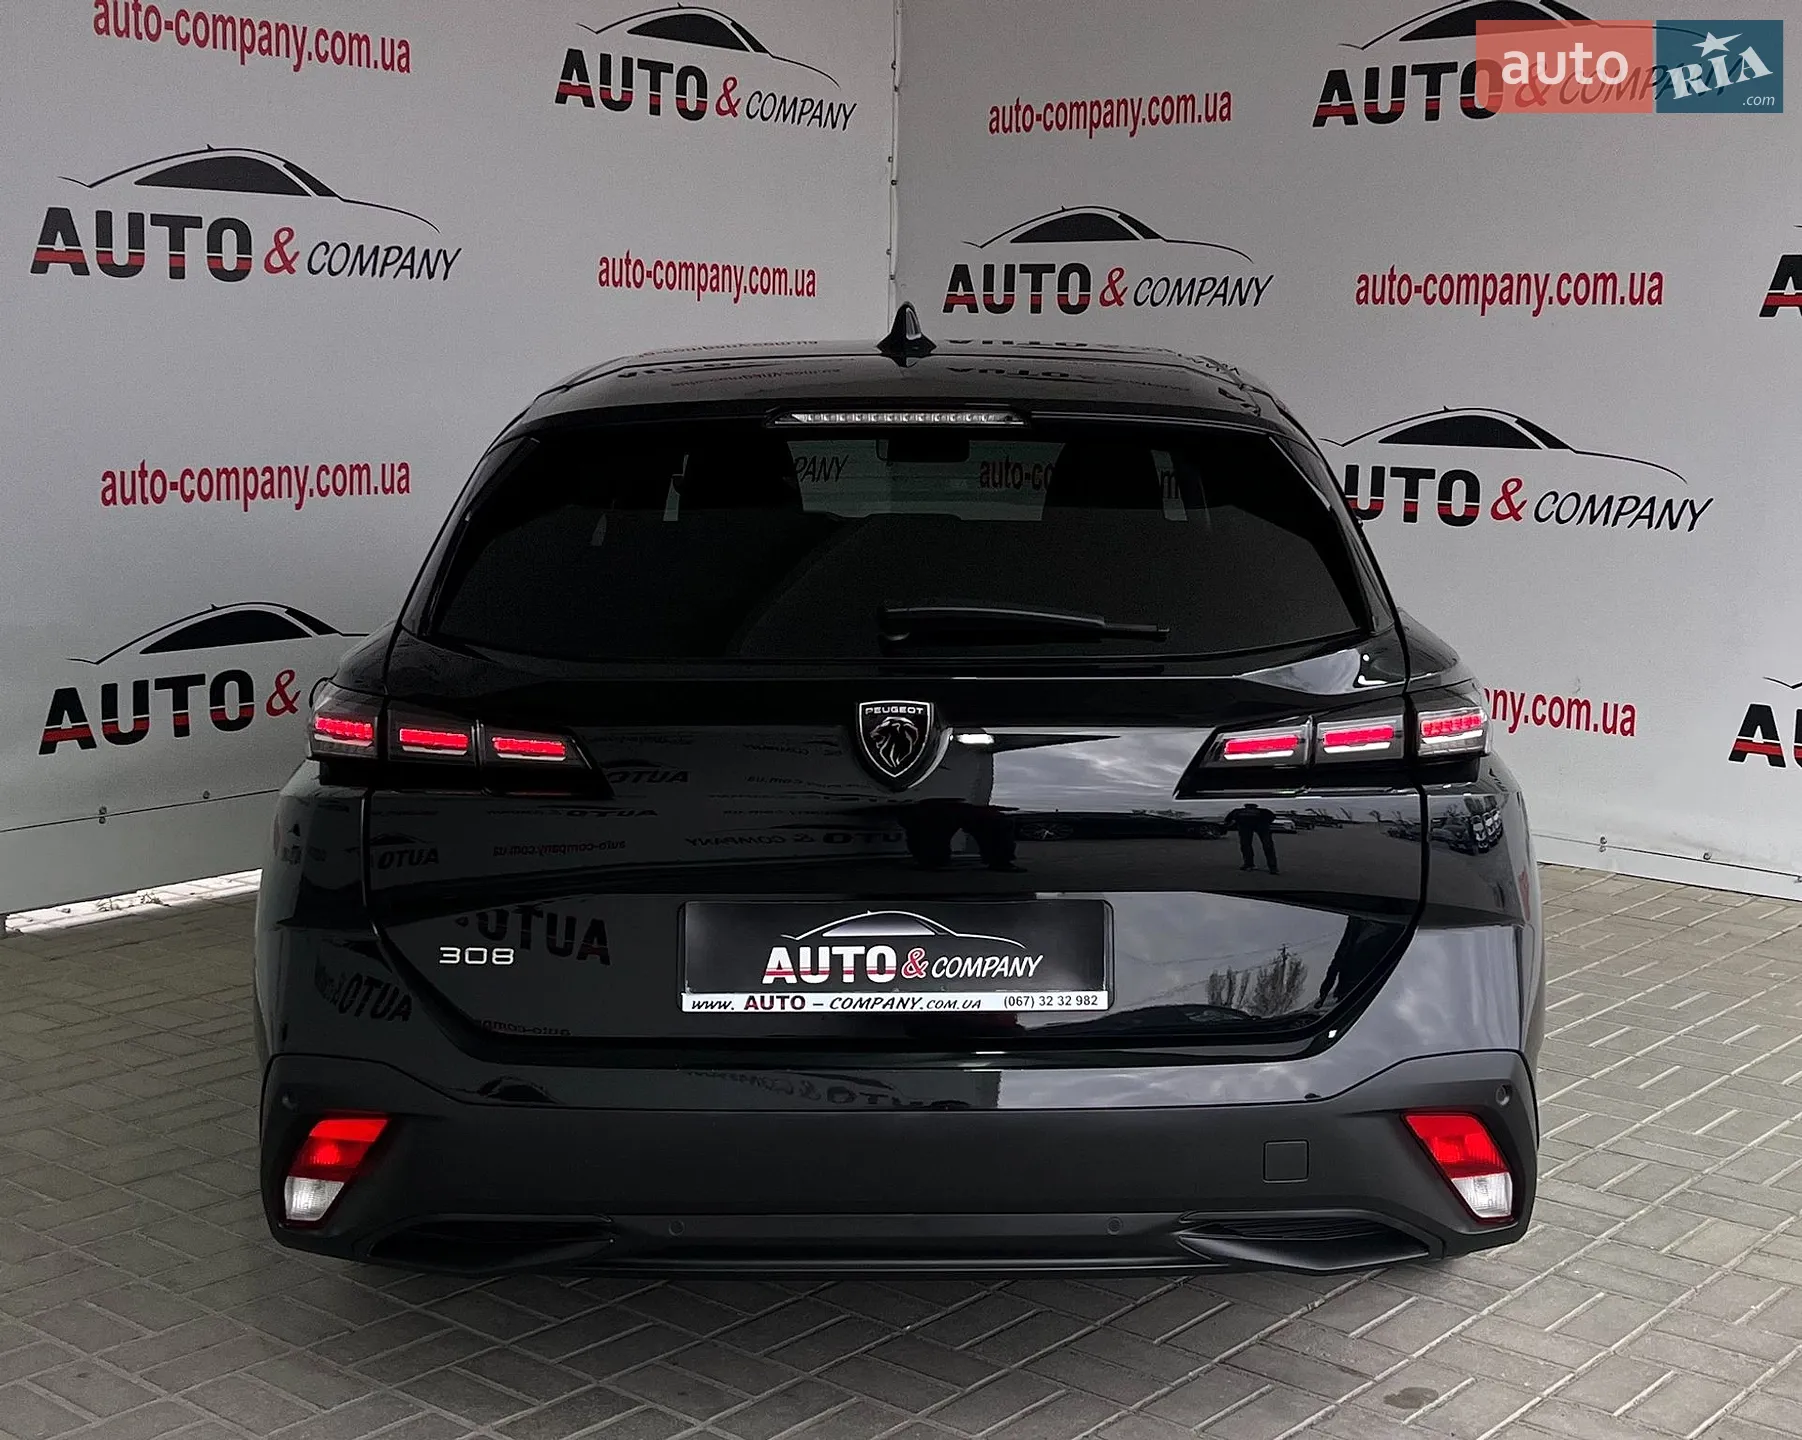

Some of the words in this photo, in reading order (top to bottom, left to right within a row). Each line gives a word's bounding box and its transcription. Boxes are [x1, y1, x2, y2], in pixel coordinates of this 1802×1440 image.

[94, 0, 411, 74] auto-company.com.ua
[556, 48, 708, 122] AUTO
[716, 77, 741, 118] &
[746, 90, 857, 132] COMPANY
[989, 90, 1232, 139] auto-company.com.ua
[1313, 59, 1503, 128] AUTO
[31, 207, 253, 283] AUTO
[264, 227, 300, 275] &
[307, 241, 462, 282] COMPANY
[599, 251, 816, 305] auto-company.com.ua
[943, 263, 1092, 315] AUTO
[1100, 268, 1128, 307] &
[1134, 275, 1274, 308] COMPANY
[1356, 266, 1664, 317] auto-company.com.ua
[101, 460, 411, 513] auto-company.com.ua
[1344, 464, 1480, 527] UTO
[1491, 478, 1528, 522] &
[1534, 491, 1714, 533] COMPANY
[39, 669, 255, 756] AUTO
[266, 670, 301, 717] &
[865, 706, 924, 715] PEUGEOT
[1484, 688, 1635, 738] ny.com.ua
[440, 946, 514, 965] 308
[762, 946, 897, 985] AUTO
[901, 947, 927, 979] &
[931, 954, 1044, 979] COMPANY
[691, 1000, 735, 1010] www.
[743, 995, 806, 1011] AUTO
[1003, 995, 1035, 1009] (067)
[1039, 996, 1054, 1007] 32
[1057, 995, 1073, 1007] 32
[1075, 995, 1098, 1007] 982
